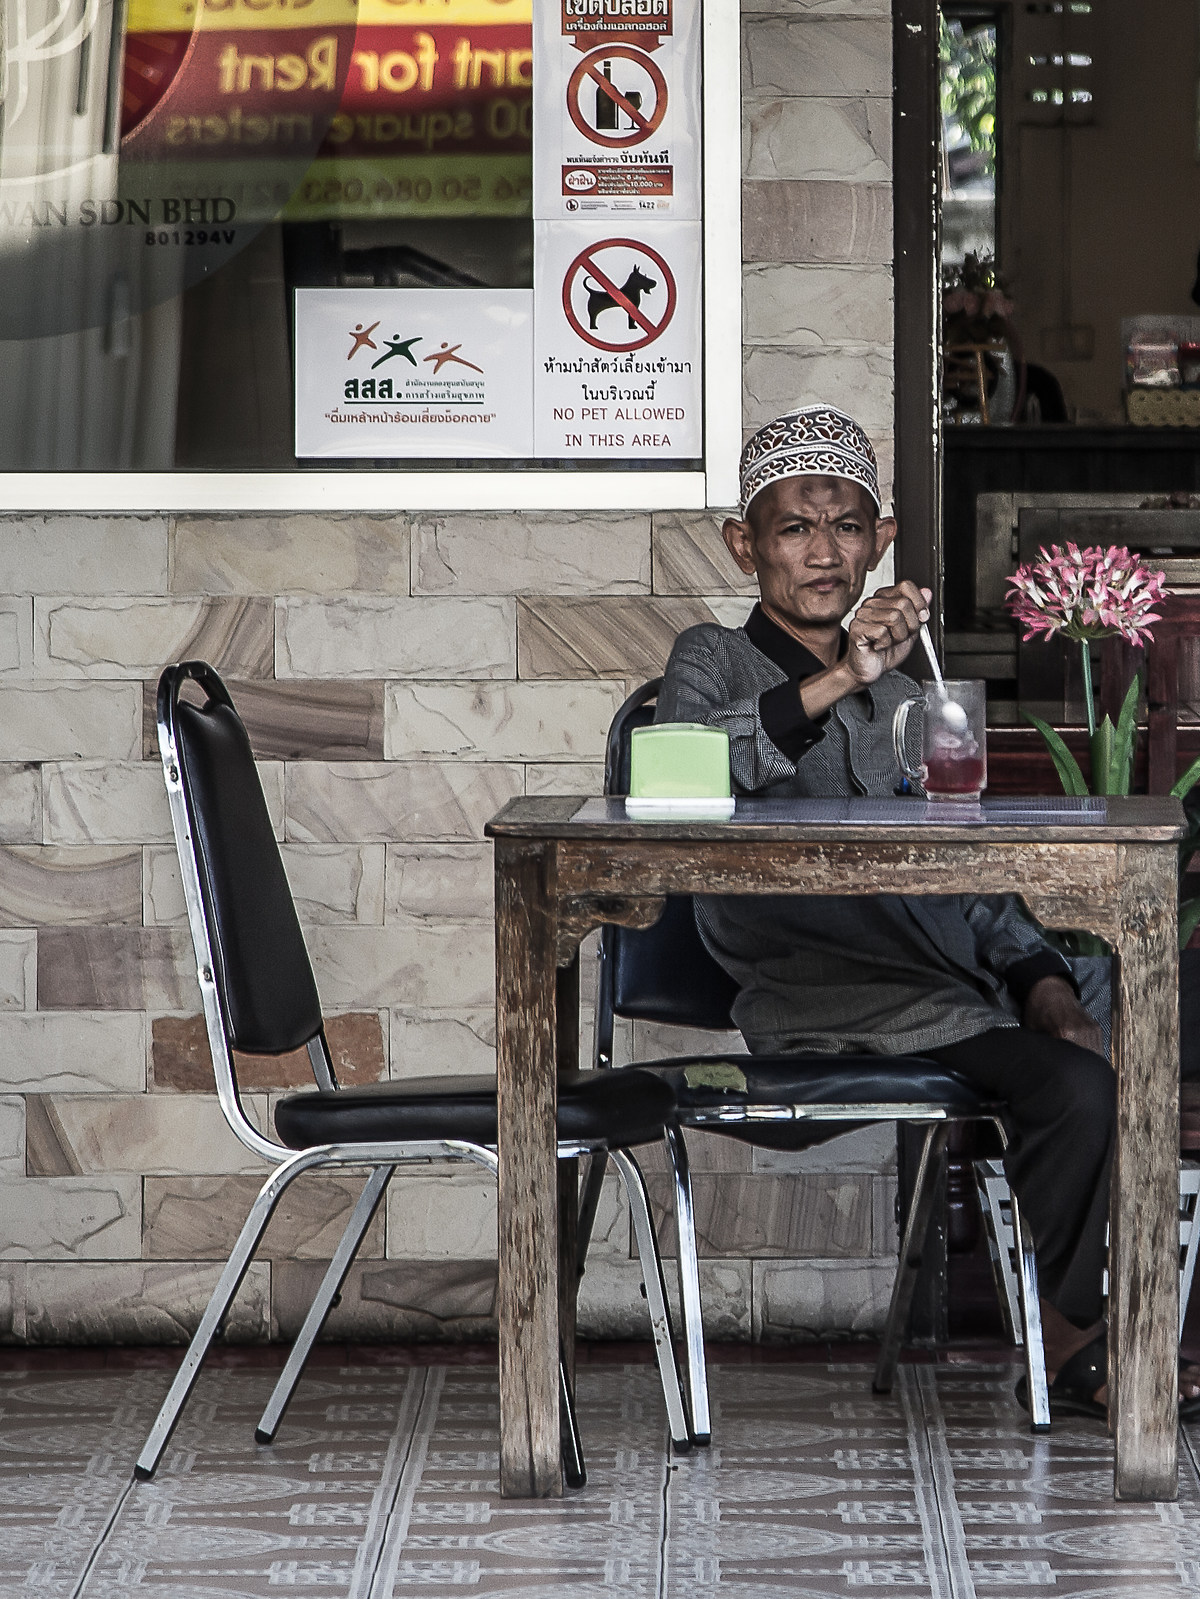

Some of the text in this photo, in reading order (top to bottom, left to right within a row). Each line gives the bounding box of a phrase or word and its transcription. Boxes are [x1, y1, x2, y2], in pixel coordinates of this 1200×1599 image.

[620, 150, 669, 163] จับทันที
[568, 173, 593, 185] ฝ่าฝืน
[79, 199, 151, 227] SDN
[162, 198, 237, 226] BHD
[145, 230, 236, 246] 801294V
[543, 353, 692, 374] ห้ามนำสัตว์เลี้ยงเข้ามา
[344, 377, 403, 399] สสส.
[581, 380, 657, 400] ในบริเวณนี้
[553, 407, 685, 420] NO PET ALLOWED
[564, 434, 672, 447] IN THIS AREA
